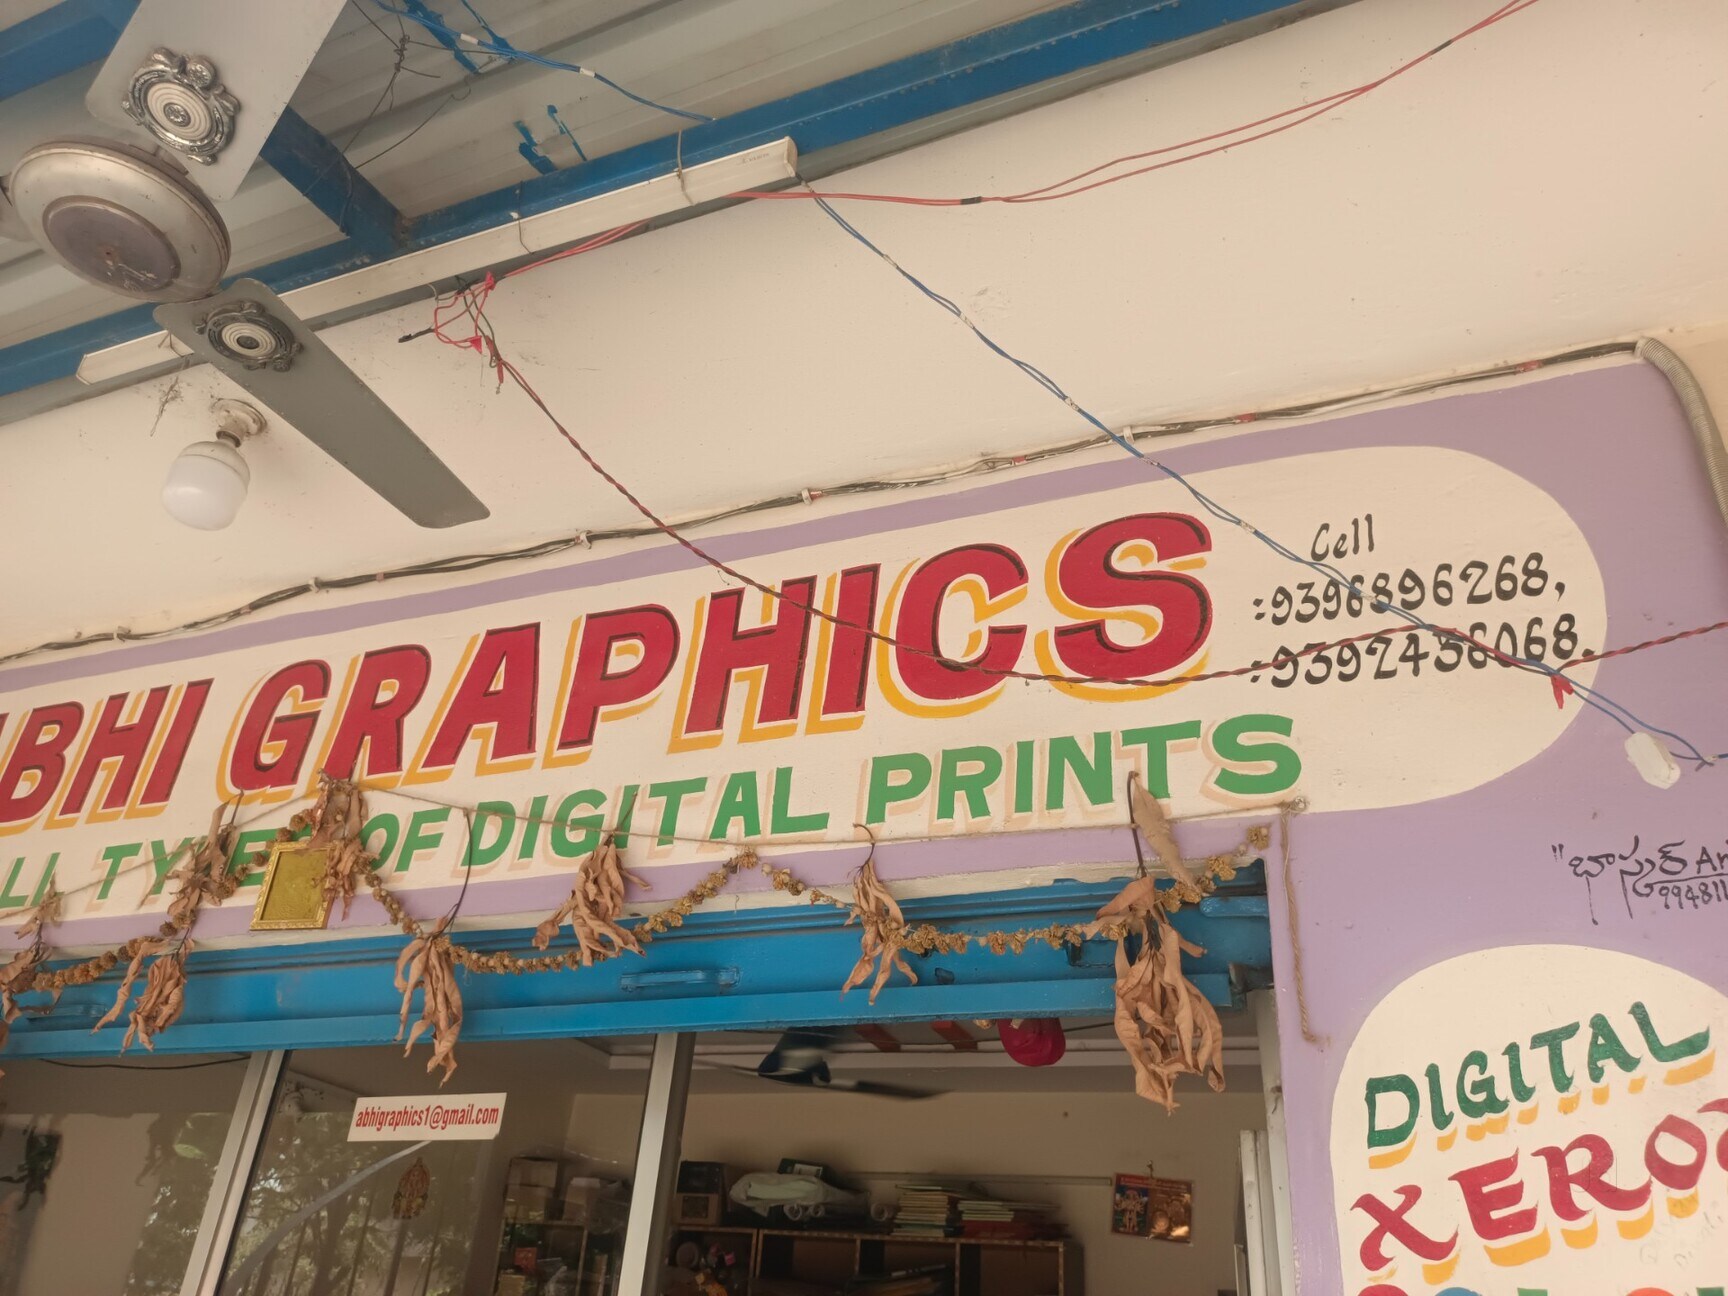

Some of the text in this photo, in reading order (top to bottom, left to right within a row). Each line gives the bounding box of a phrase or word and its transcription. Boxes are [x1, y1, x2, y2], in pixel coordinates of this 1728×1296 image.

[1310, 513, 1375, 562] Cell
[0, 511, 1213, 823] BHI GRAPHICS
[356, 806, 452, 876] OF
[460, 767, 829, 868] DIGITAL
[866, 713, 1302, 825] PRINTS
[355, 1103, 500, 1132] abhigraphics1@gmail.com
[1364, 1000, 1710, 1149] DIGITAL
